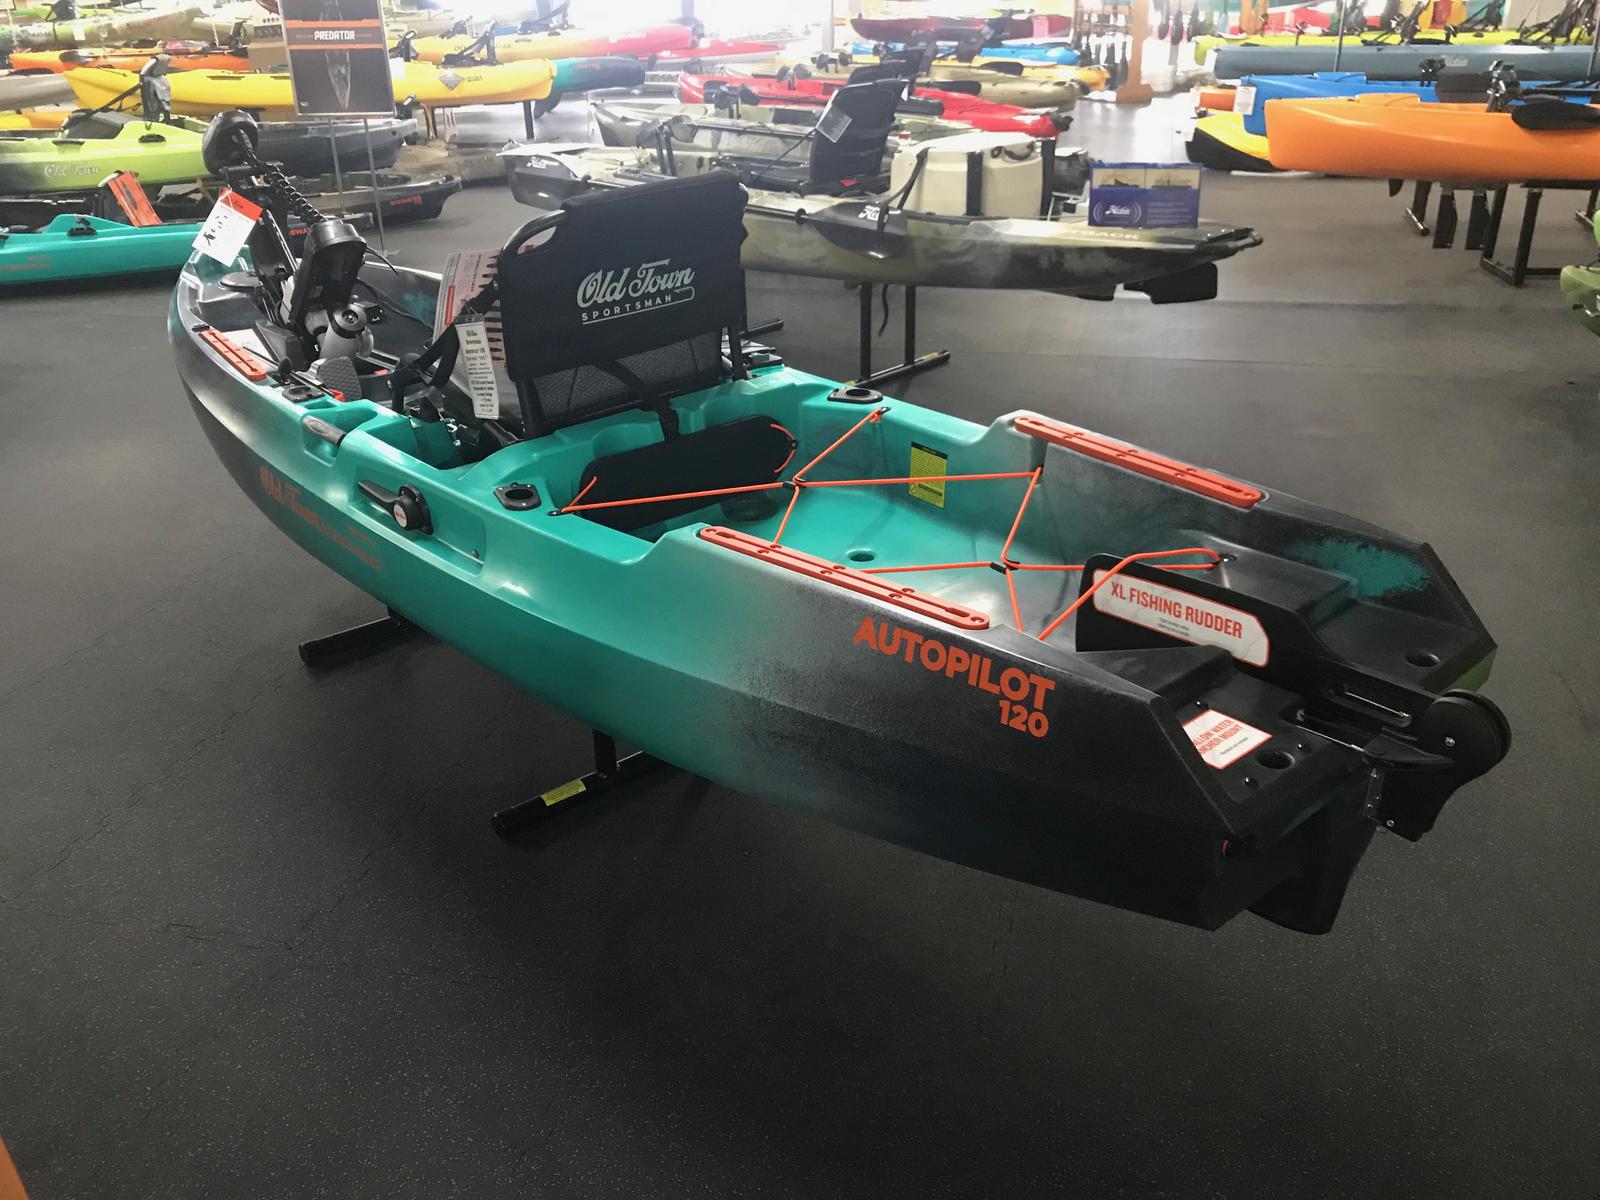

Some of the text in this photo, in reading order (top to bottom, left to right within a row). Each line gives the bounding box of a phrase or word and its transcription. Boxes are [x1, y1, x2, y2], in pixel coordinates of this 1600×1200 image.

[314, 30, 355, 40] PREDATOR
[577, 258, 695, 308] Old Town
[581, 294, 672, 321] SPORTSMAN
[1111, 581, 1126, 600] XL
[1129, 587, 1182, 619] FISHING
[1185, 605, 1242, 639] RUDDER
[853, 616, 1056, 738] AUTOPILOT 120
[1209, 719, 1235, 733] WATER
[1219, 724, 1244, 740] MOUNT
